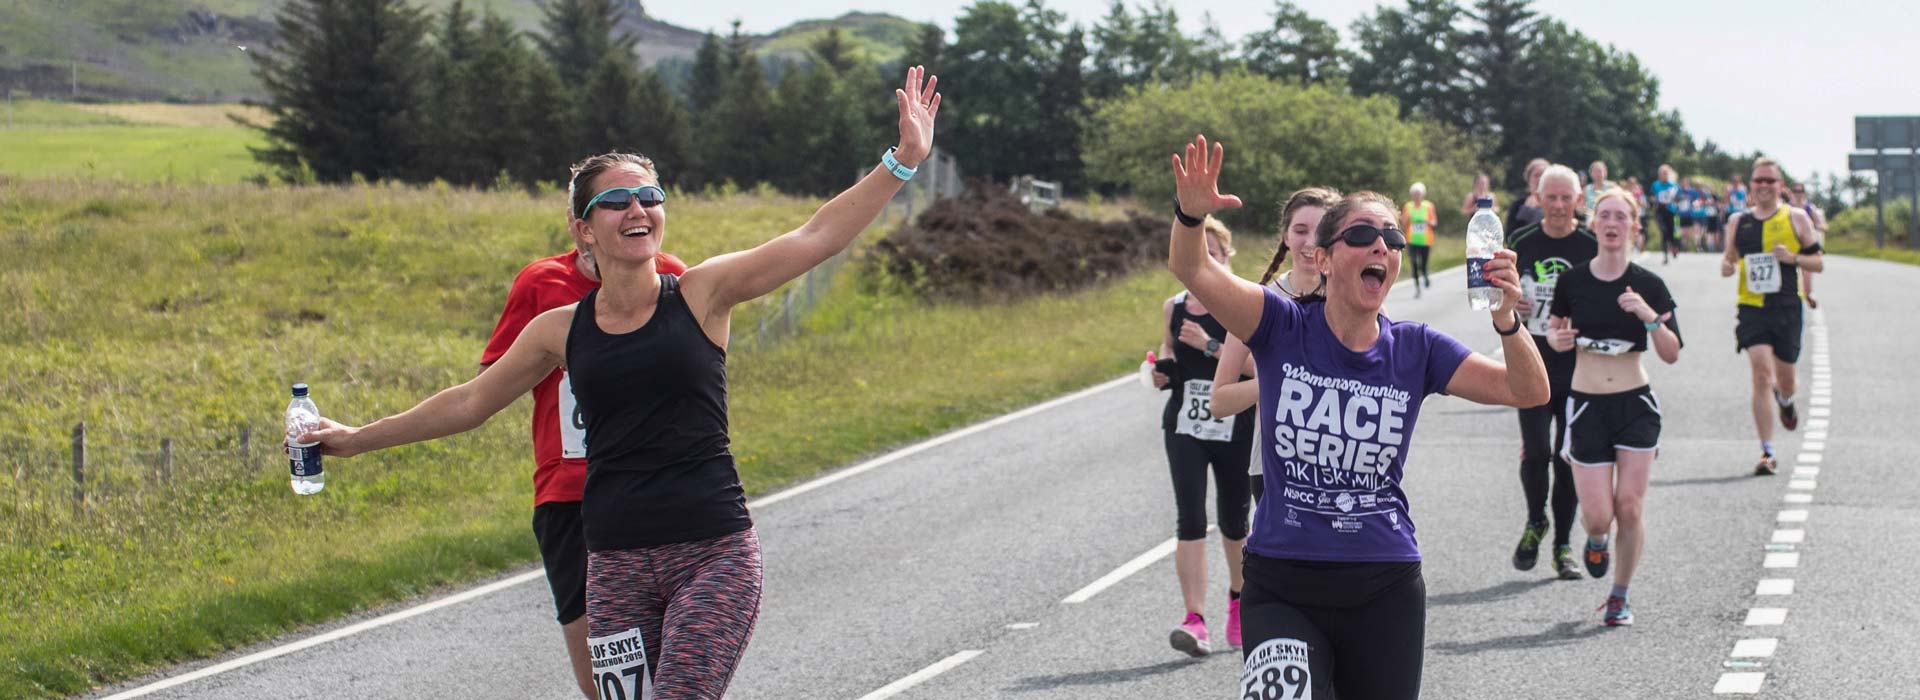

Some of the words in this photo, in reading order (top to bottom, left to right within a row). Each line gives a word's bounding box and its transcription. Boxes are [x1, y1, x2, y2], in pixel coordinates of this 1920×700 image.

[1750, 265, 1774, 281] 627
[1536, 299, 1551, 319] 7
[1282, 363, 1349, 390] Women's
[1349, 379, 1411, 407] Running
[1187, 398, 1224, 424] 85
[1275, 377, 1408, 446] RACE
[1274, 424, 1398, 475] SERIES
[593, 644, 606, 659] OF
[608, 636, 641, 656] SKYE
[624, 651, 644, 663] 2019
[1243, 665, 1308, 700] 589
